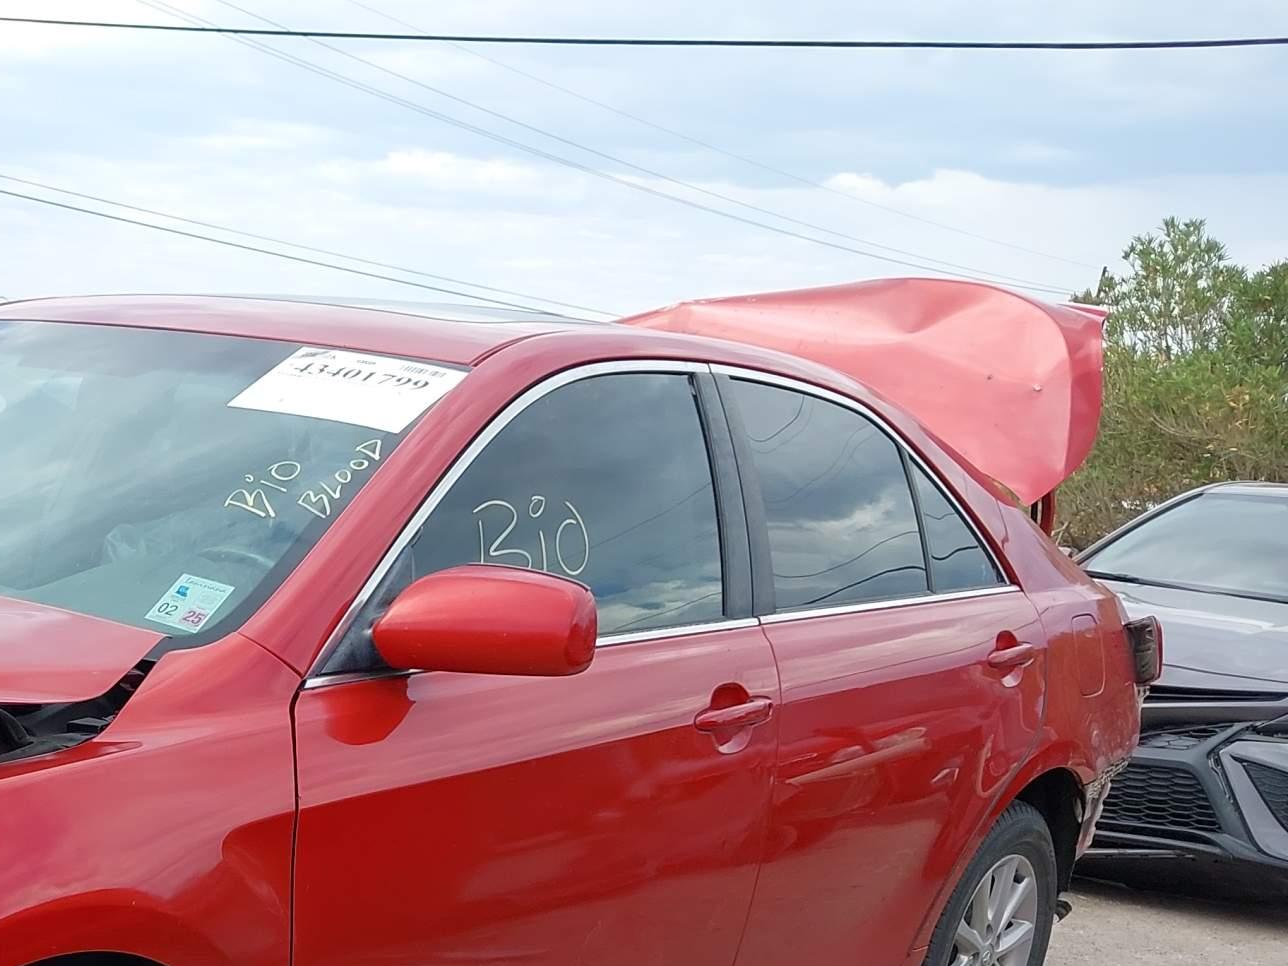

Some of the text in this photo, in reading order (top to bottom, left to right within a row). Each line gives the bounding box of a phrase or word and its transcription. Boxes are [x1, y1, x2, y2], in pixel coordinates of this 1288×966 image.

[293, 362, 430, 390] 43401799
[157, 602, 179, 616] 02
[182, 610, 206, 625] 25
